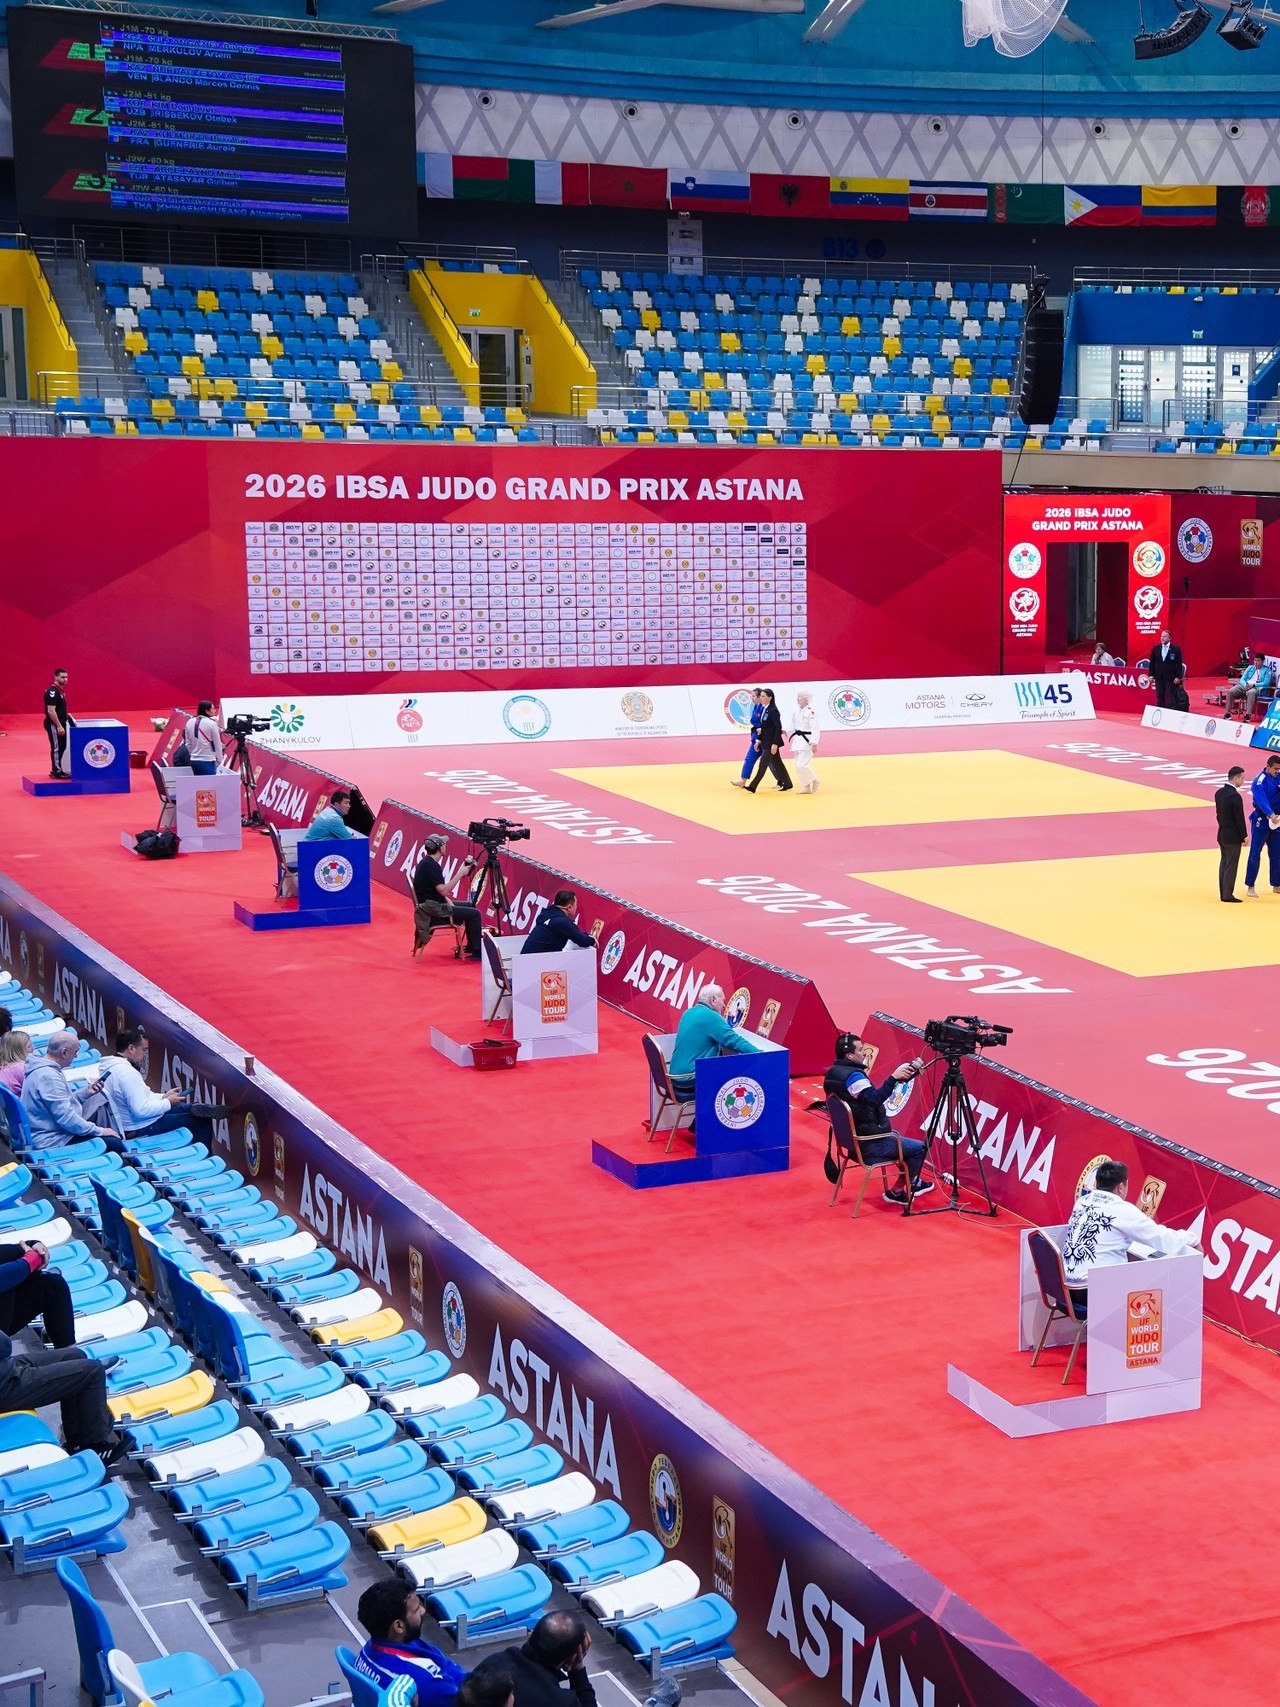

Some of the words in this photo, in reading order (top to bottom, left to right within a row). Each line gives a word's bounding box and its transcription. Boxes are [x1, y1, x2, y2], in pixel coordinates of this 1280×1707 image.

[123, 42, 143, 51] NPA
[149, 44, 203, 56] MERKULOV
[128, 73, 147, 81] VEN
[153, 75, 193, 85] BLANCO
[195, 79, 228, 88] Marcos
[245, 474, 326, 499] 2026
[336, 475, 410, 499] IBSA
[417, 476, 497, 500] JUDO
[505, 477, 611, 501] GRAND
[620, 478, 690, 501] PRIX
[696, 478, 804, 501] ASTANA
[1045, 508, 1072, 518] 2026
[1075, 508, 1099, 518] IBSA
[1102, 508, 1131, 518] JUDO
[1032, 521, 1071, 531] GRAND
[1074, 521, 1098, 531] PRIX
[1101, 520, 1144, 531] ASTANA
[1242, 558, 1261, 566] TOUR
[1083, 671, 1137, 688] ASTANA
[917, 694, 946, 702] ASTANA
[1044, 683, 1073, 705] 45
[905, 700, 946, 710] MOTORS
[1020, 709, 1048, 720] Triumph
[1057, 708, 1076, 719] Spirit
[259, 736, 321, 745] ZHANYKULOV
[1046, 742, 1169, 763] 2026
[257, 774, 310, 822] ASTANA
[423, 769, 538, 796] 2026
[489, 794, 675, 844] ASTANA
[696, 875, 852, 914] 2026
[801, 912, 1074, 995] ASTANA
[623, 944, 716, 1010] ASTAN
[53, 961, 108, 1047] ASTANA
[544, 1000, 565, 1008] JUDO
[920, 1091, 1056, 1193] ASTANA
[300, 1162, 393, 1296] ASTANA
[1130, 1324, 1160, 1334] WORLD
[1139, 1317, 1151, 1326] IJF
[1130, 1332, 1159, 1346] JUDO
[1129, 1342, 1160, 1355] TOUR
[1129, 1356, 1159, 1368] ASTANA
[488, 1322, 622, 1501] ASTANA
[714, 1550, 733, 1571] WORLD
[714, 1574, 733, 1601] TOUR
